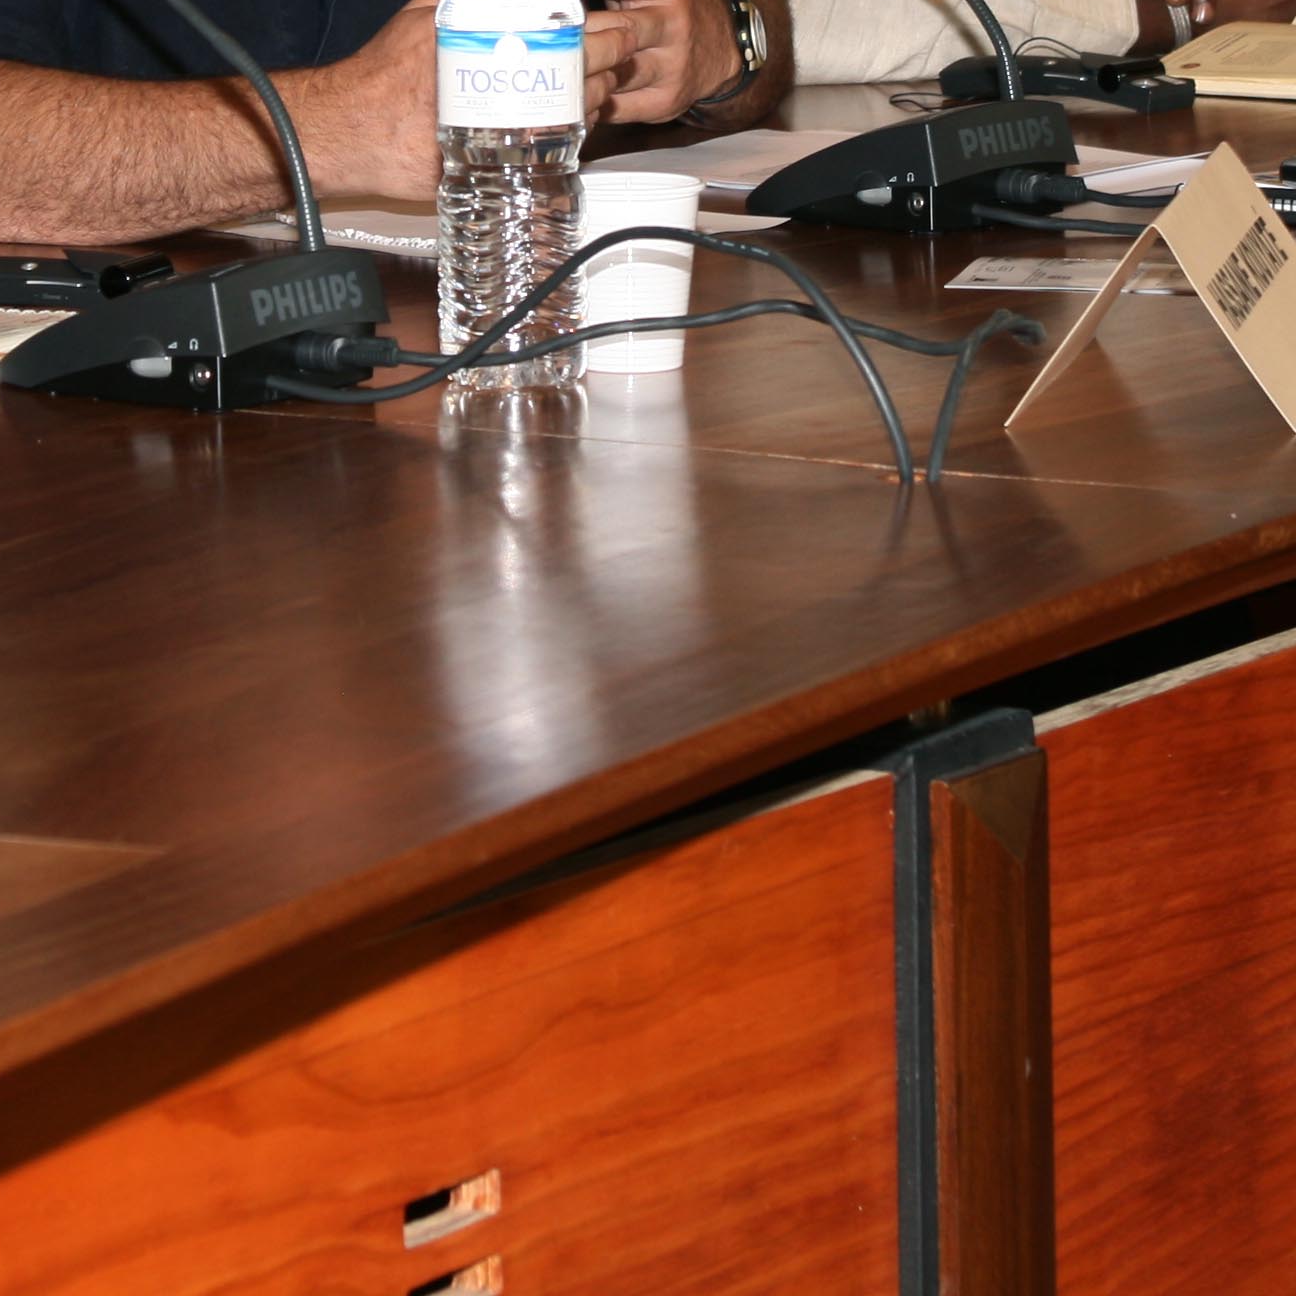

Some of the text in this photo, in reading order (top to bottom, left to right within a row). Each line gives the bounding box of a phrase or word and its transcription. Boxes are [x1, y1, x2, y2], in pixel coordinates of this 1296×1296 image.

[455, 68, 564, 93] TOSCAL
[958, 115, 1055, 159] PHILIPS
[250, 271, 363, 326] PHILIPS
